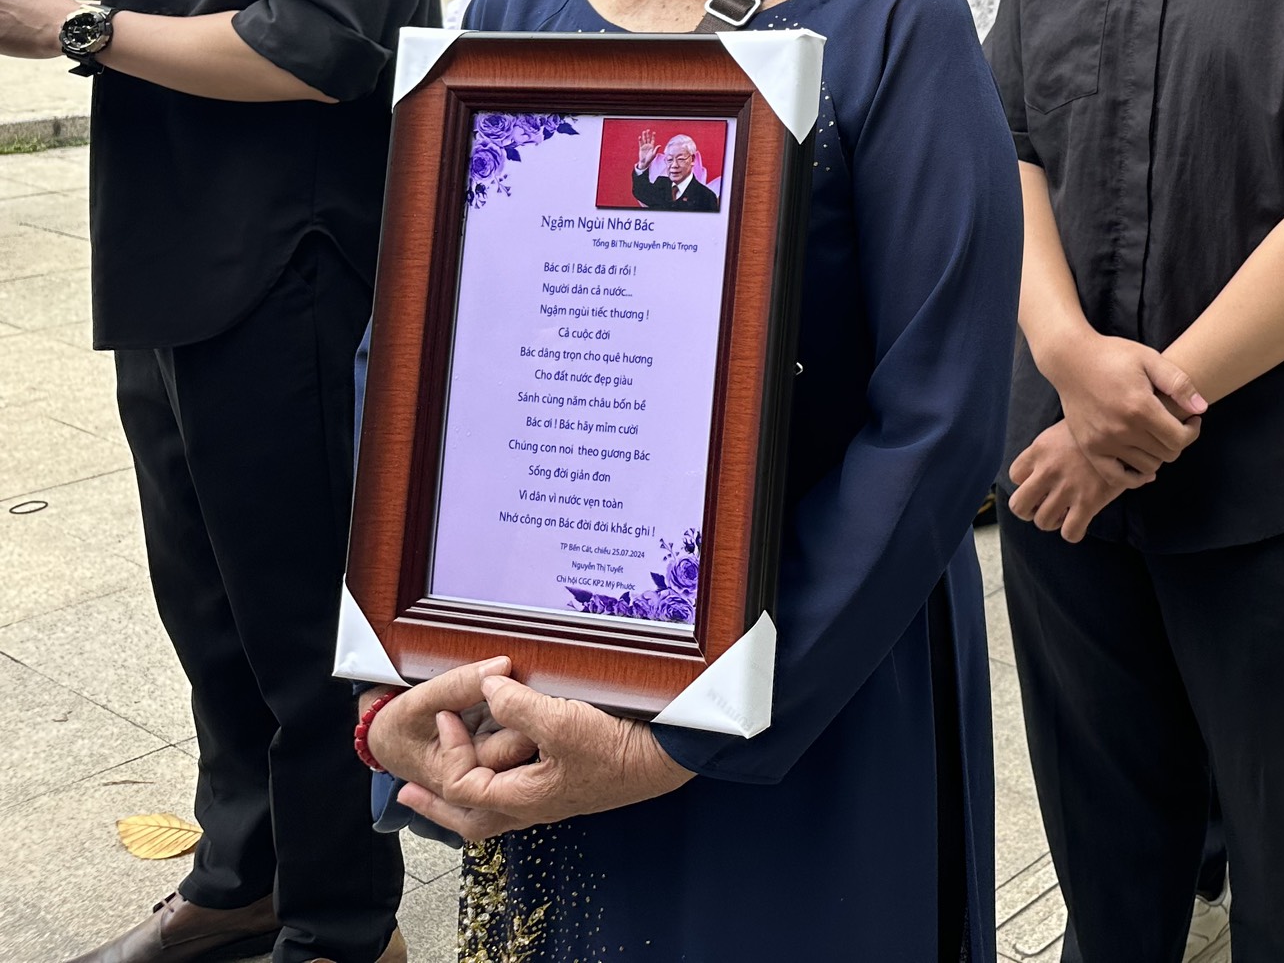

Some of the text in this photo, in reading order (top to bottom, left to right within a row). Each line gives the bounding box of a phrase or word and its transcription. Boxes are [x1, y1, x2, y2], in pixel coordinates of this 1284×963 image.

[541, 215, 654, 232] Ngậm Ngùi Nhớ Bác
[619, 240, 632, 248] Thư
[633, 240, 660, 250] Nguyễn
[662, 241, 676, 250] Phú
[677, 242, 697, 252] Trọng
[544, 261, 559, 272] Bác
[561, 263, 570, 272] ơi
[576, 263, 592, 273] Bác
[594, 264, 605, 274] đã
[608, 264, 616, 274] đi
[542, 282, 569, 295] Người
[571, 284, 588, 294] dân
[590, 285, 600, 295] cả
[540, 304, 566, 317] Ngậm
[569, 306, 589, 318] ngùi
[591, 306, 607, 317] tiếc
[610, 308, 644, 322] thương
[558, 327, 610, 340] Cả cuộc đời
[520, 346, 653, 367] Bác dâng trọn cho quê hương
[534, 369, 632, 387] Cho đất nước đẹp giàu
[517, 391, 539, 402] Sánh
[541, 393, 564, 407] cùng
[566, 396, 586, 406] năm
[588, 397, 610, 408] châu
[613, 398, 631, 409] bốn
[526, 416, 542, 427] Bác
[543, 418, 552, 428] ơi
[559, 418, 575, 430] Bác
[577, 420, 594, 434] hãy
[595, 422, 616, 433] mỉm
[618, 424, 638, 434] cười
[508, 439, 650, 462] Chúng con noi theo gương Bác
[528, 464, 610, 482] Sống đời giản đơn
[529, 490, 546, 501] dân
[548, 492, 556, 503] vì
[558, 494, 581, 505] nước
[583, 498, 599, 508] vẹn
[602, 498, 623, 509] toàn
[499, 511, 519, 523] Nhớ
[520, 514, 542, 528] công
[544, 518, 556, 526] ơn
[559, 517, 574, 528] Bác
[576, 519, 591, 530] đời
[593, 521, 608, 532] đời
[611, 522, 632, 534] khắc
[634, 525, 649, 538] ghi
[560, 542, 568, 550] TP
[568, 543, 580, 551] Bến
[571, 560, 623, 574] Nguyễn Thị Tuyết
[556, 575, 567, 583] Chi
[567, 576, 577, 585] hội
[578, 577, 591, 586] CGC
[592, 579, 604, 587] KP2
